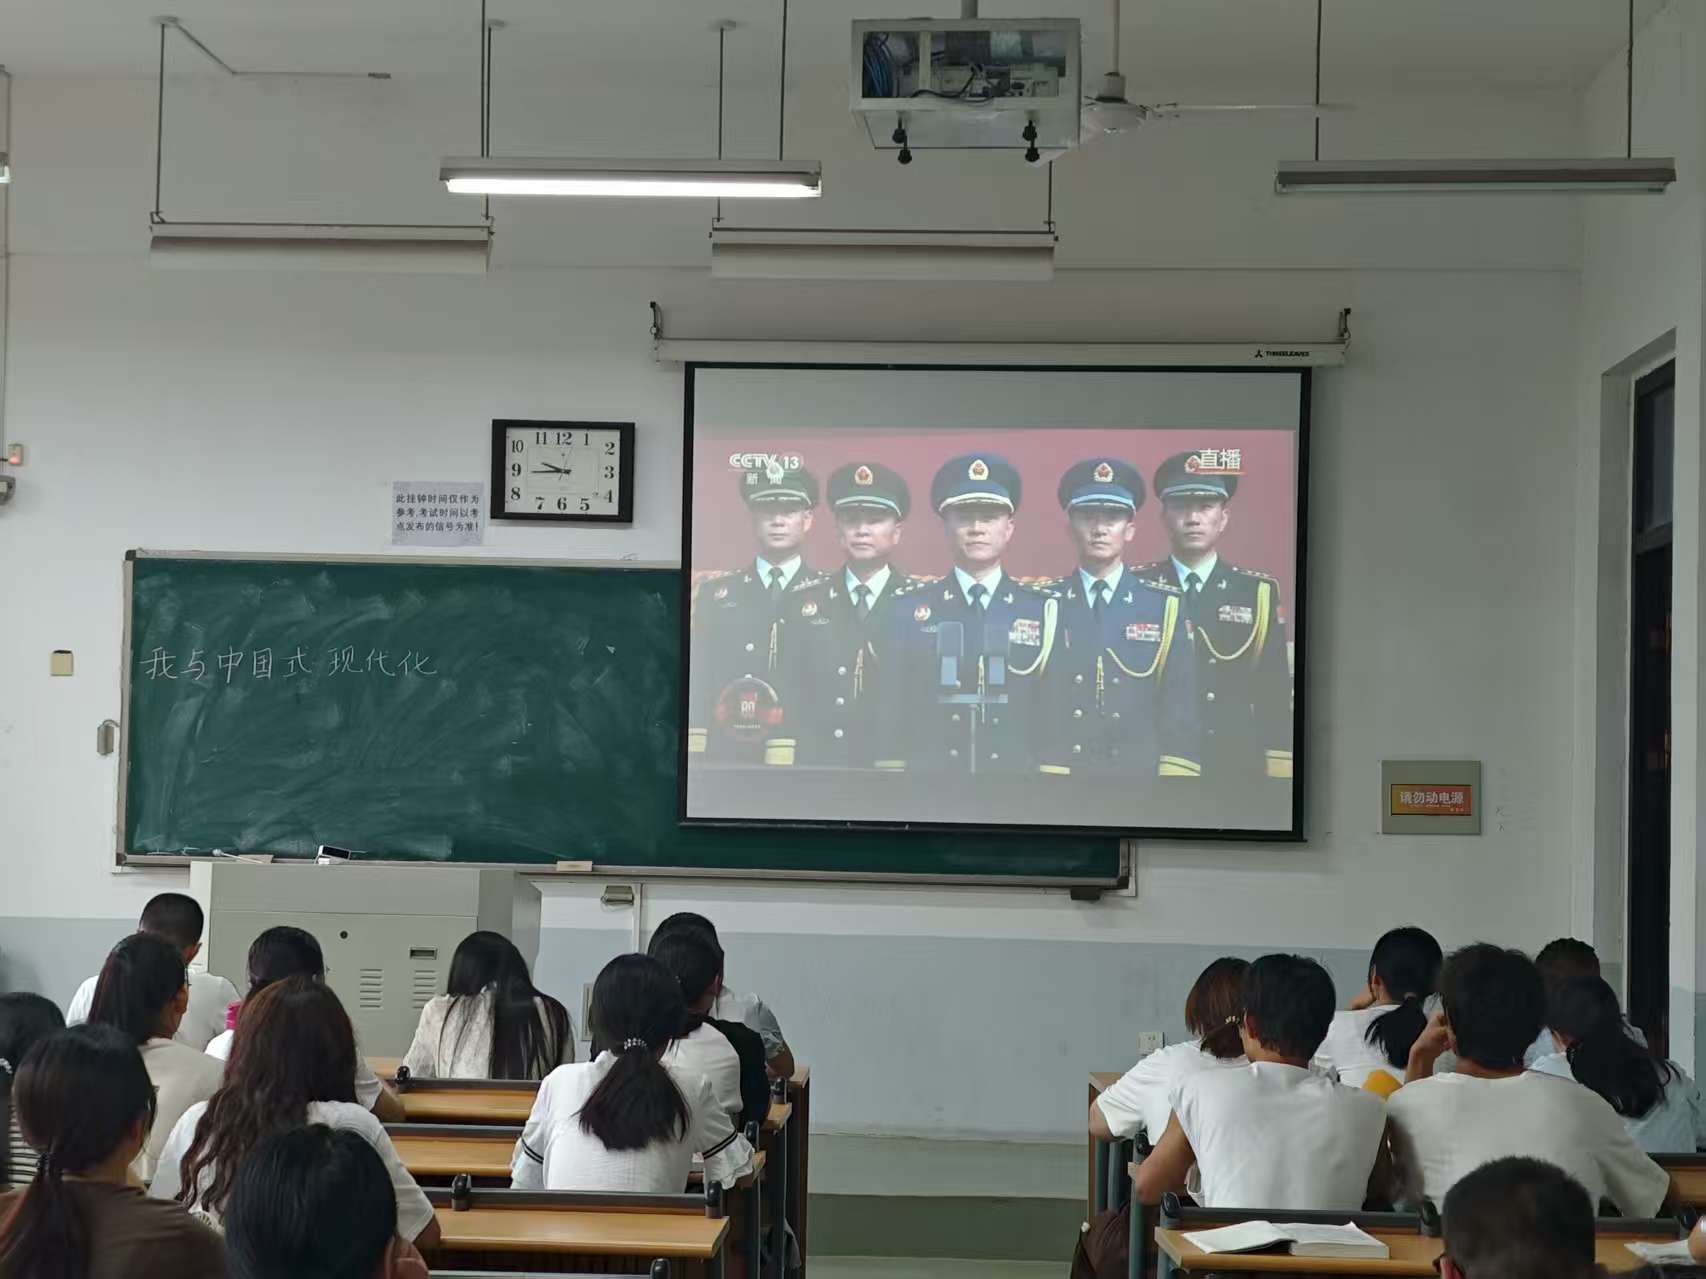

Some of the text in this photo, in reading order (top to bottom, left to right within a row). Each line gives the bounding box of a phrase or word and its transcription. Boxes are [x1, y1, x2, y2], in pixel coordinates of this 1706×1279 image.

[536, 431, 547, 445] 11
[556, 431, 572, 445] 12
[584, 432, 589, 446] 1
[511, 439, 524, 453] 10
[604, 441, 616, 455] 2
[729, 453, 799, 469] CCTV 13
[1199, 447, 1241, 470] 直播
[511, 463, 522, 477] 9
[604, 465, 615, 479] 3
[396, 494, 479, 504] 此挂钟时间仅作为
[510, 486, 521, 500] 8
[603, 489, 613, 503] 4
[535, 496, 545, 510] 7
[557, 497, 567, 511] 6
[580, 498, 590, 511] 5
[140, 645, 437, 684] 我与中国式现代化
[1400, 791, 1463, 804] 请勿动电源
